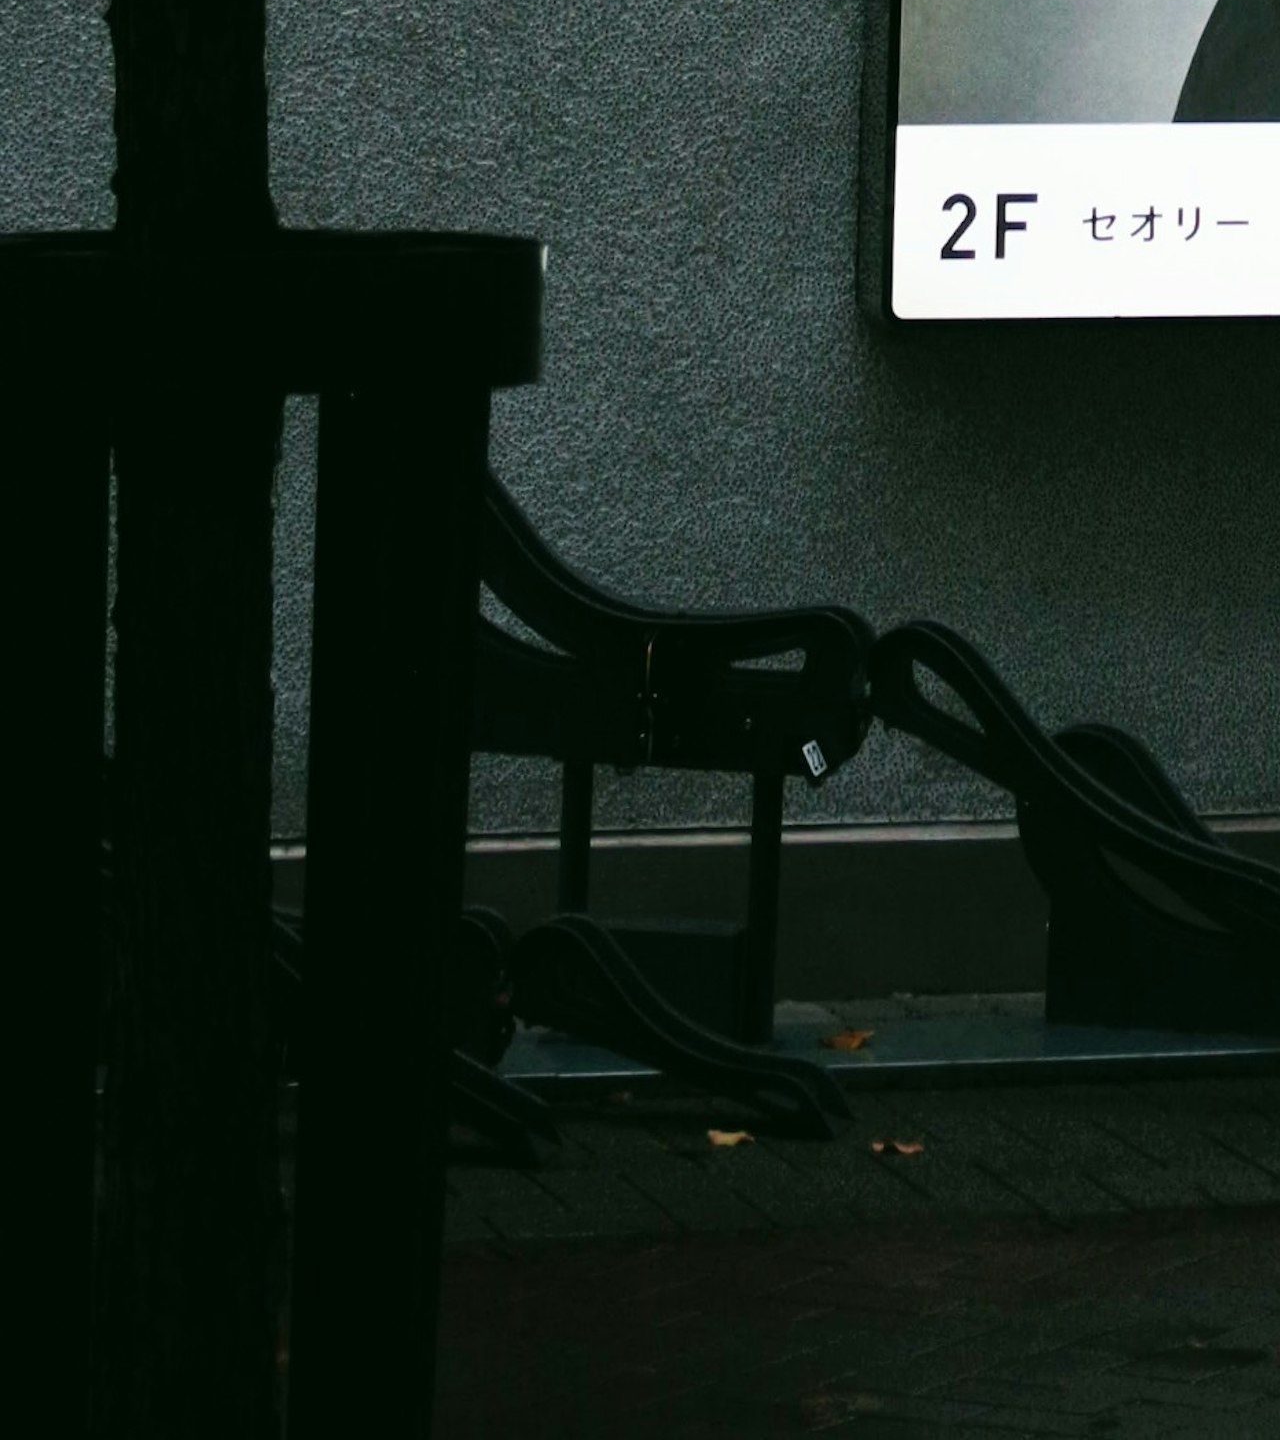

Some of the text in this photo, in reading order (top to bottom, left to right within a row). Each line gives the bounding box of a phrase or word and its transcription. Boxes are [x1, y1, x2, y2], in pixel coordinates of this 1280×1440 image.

[940, 193, 1250, 260] 2F セオリー
